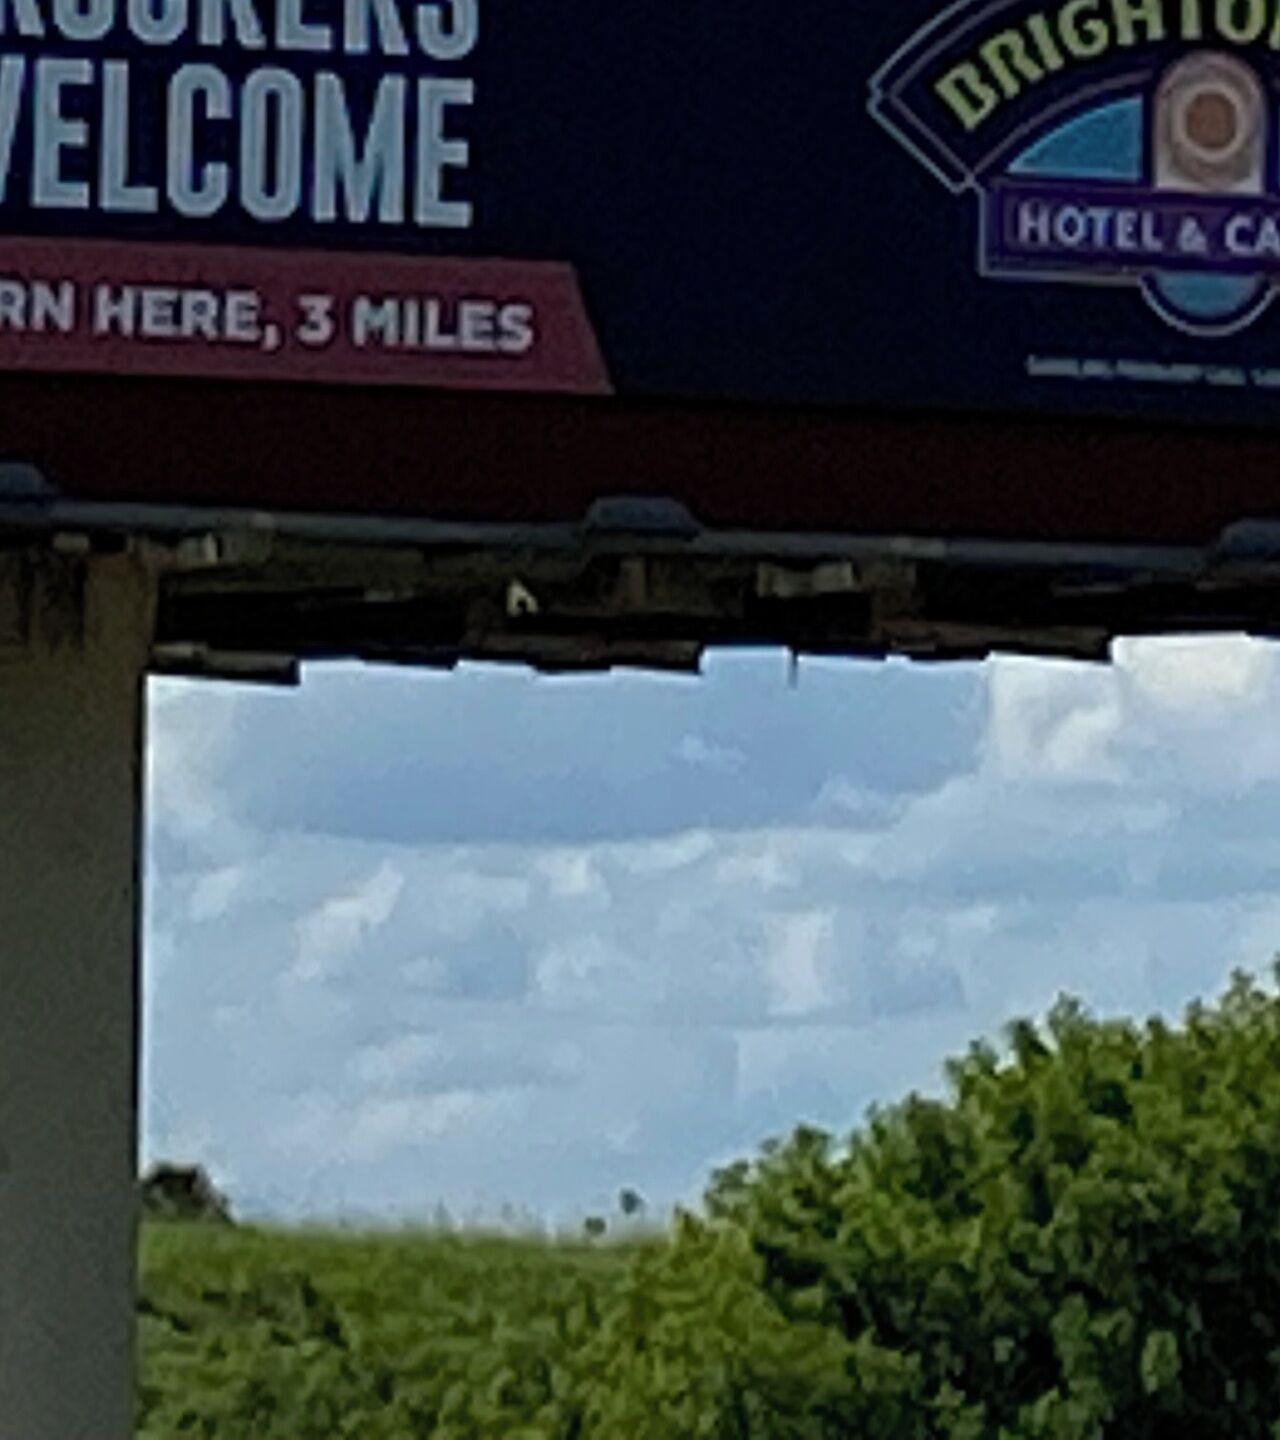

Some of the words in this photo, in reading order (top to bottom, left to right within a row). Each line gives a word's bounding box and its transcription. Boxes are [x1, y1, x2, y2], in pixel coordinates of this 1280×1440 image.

[1021, 205, 1163, 251] HOTEL
[1177, 216, 1208, 252] &
[93, 284, 280, 351] HERE,
[297, 294, 336, 344] 3
[352, 297, 535, 354] MILES
